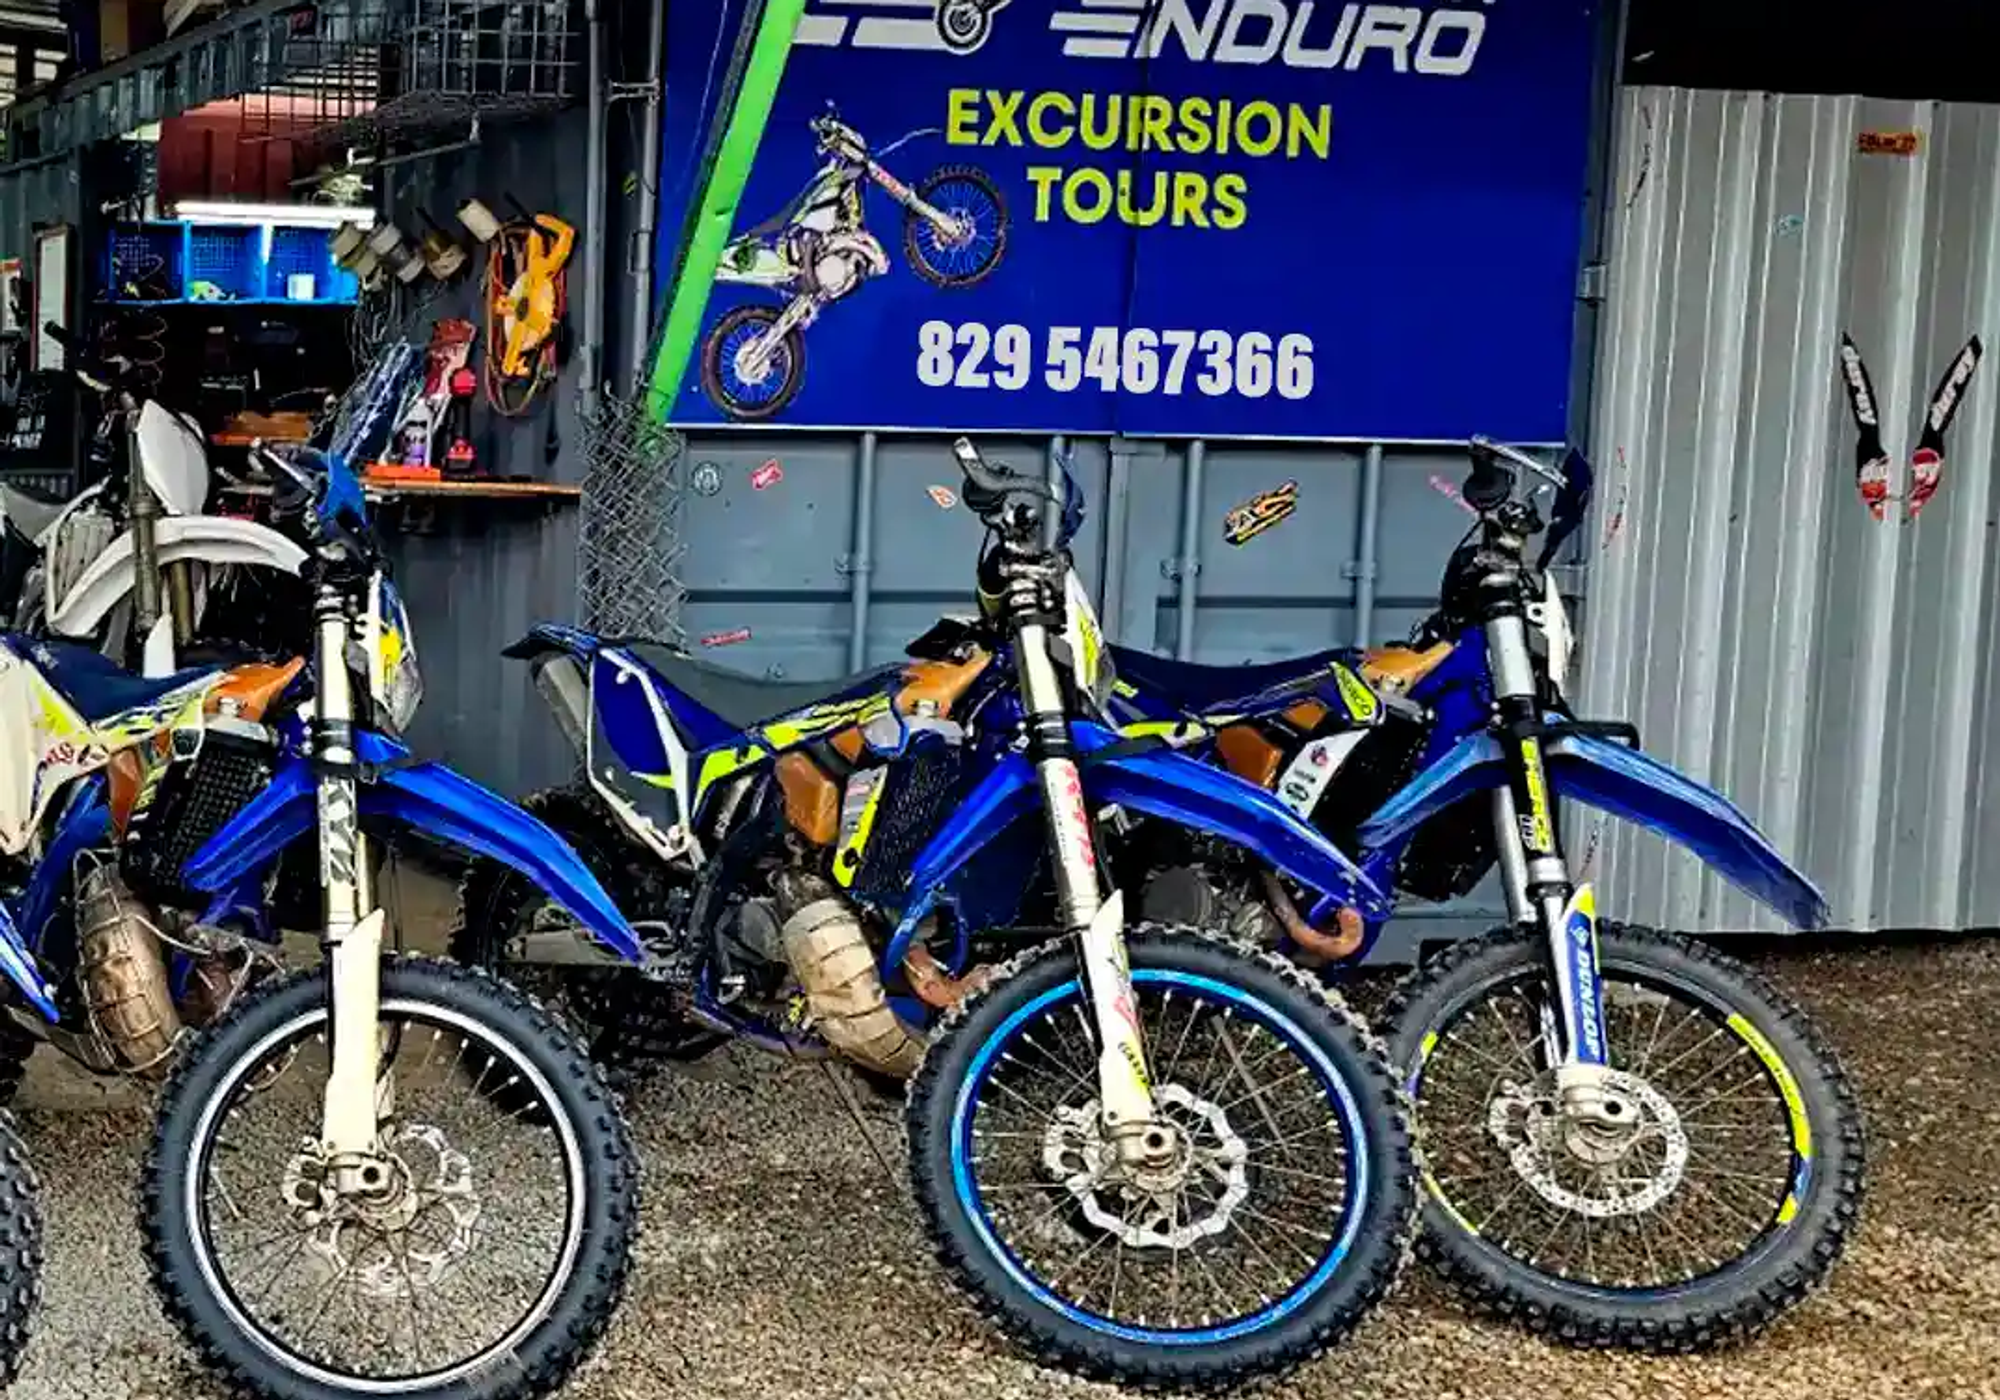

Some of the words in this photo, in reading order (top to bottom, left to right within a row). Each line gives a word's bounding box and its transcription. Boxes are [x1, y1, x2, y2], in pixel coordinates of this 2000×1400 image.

[1049, 0, 1486, 76] ENDURO
[947, 88, 1332, 160] EXCURSION
[1026, 167, 1248, 229] TOURS
[917, 320, 1032, 390] 829
[1044, 326, 1315, 400] 5467366
[1577, 948, 1602, 1060] DUNLOP
